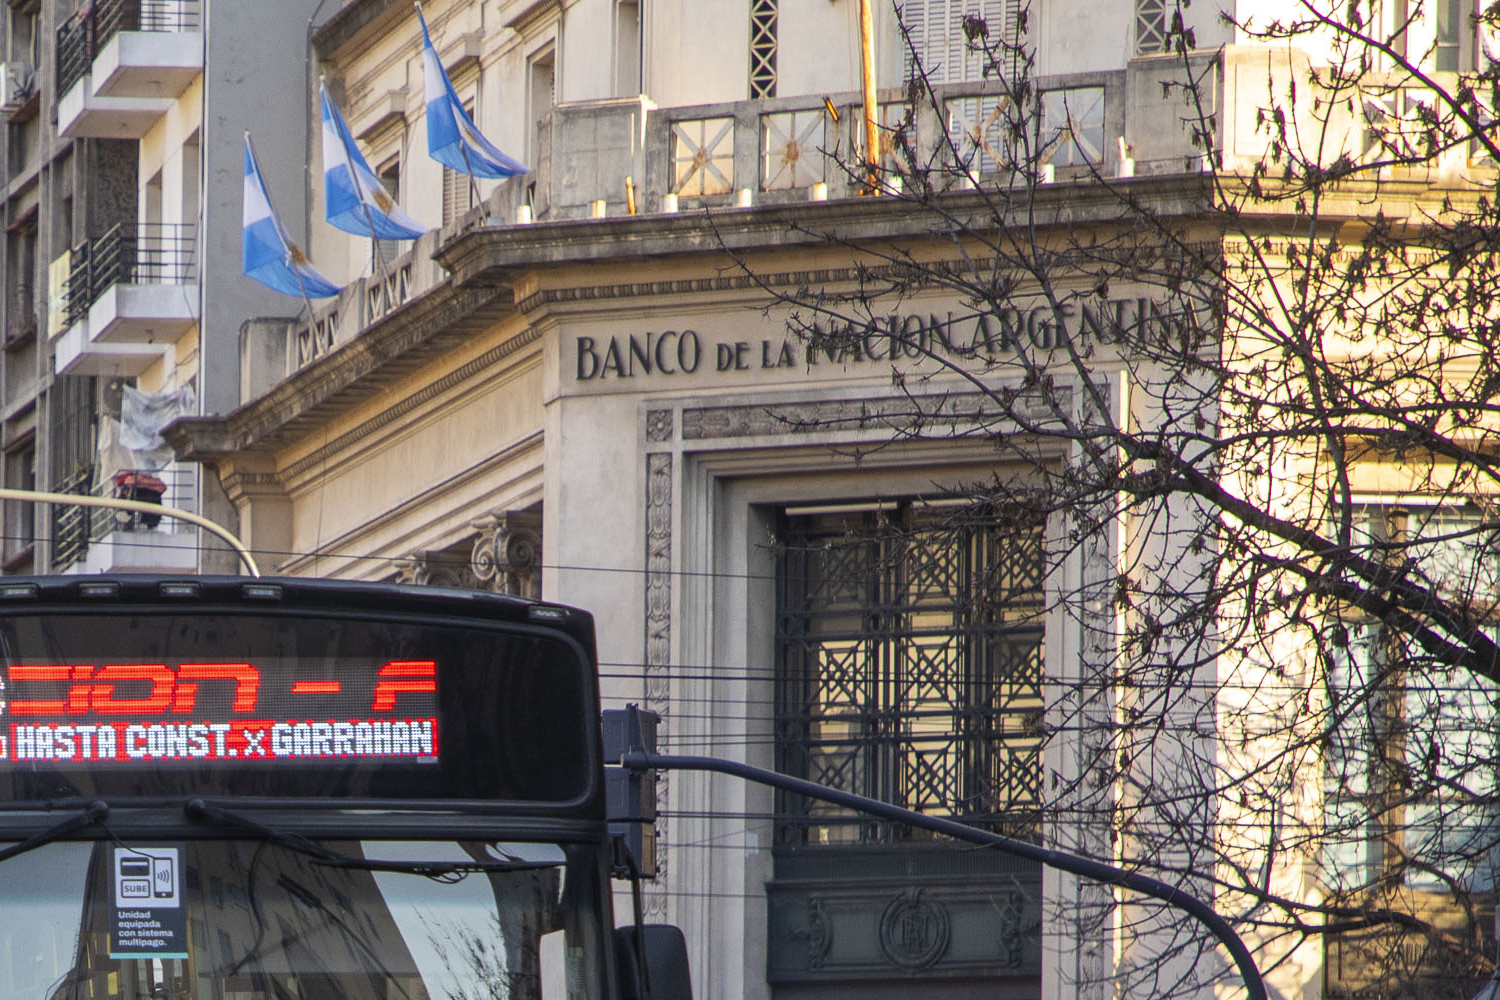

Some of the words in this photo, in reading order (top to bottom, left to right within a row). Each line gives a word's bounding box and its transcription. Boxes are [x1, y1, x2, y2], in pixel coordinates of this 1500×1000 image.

[575, 330, 701, 381] BANCO
[716, 342, 750, 372] DE
[761, 338, 797, 370] LA
[15, 724, 117, 759] HASTA
[124, 723, 238, 758] CONST.
[271, 720, 434, 757] GARRAHAN
[124, 885, 148, 893] SUBE
[118, 911, 151, 919] Unidad
[118, 920, 161, 929] equipada
[137, 929, 174, 937] sistema
[118, 938, 168, 948] multipago.
